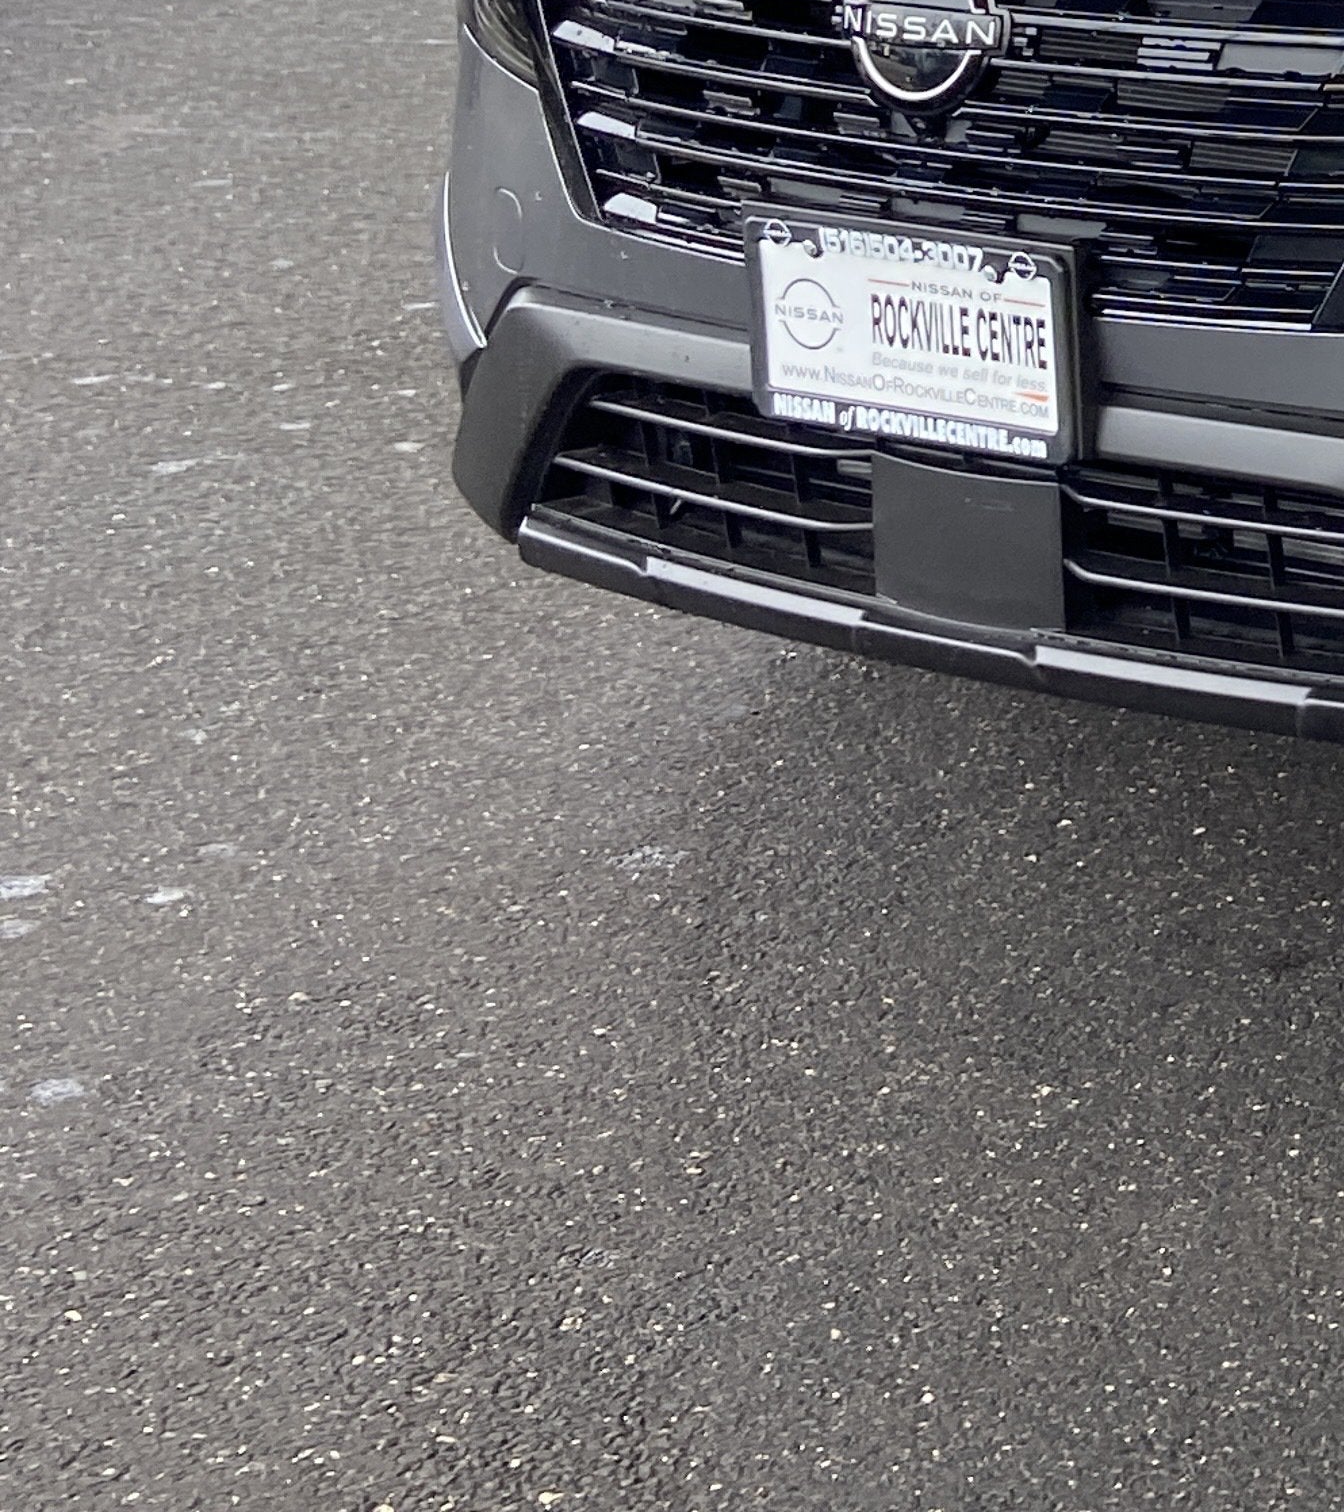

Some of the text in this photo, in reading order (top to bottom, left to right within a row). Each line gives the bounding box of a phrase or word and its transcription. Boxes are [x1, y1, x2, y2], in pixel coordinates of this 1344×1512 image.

[843, 4, 996, 46] NISSAN
[911, 280, 1002, 303] NISSAN OF
[774, 303, 844, 325] NISSAN
[871, 293, 1048, 370] ROCKVILLE CENTRE
[872, 351, 934, 375] Because
[938, 366, 960, 379] we
[962, 367, 989, 384] sell
[993, 370, 1012, 386] for
[773, 392, 836, 425] NISSAN
[839, 405, 856, 431] of
